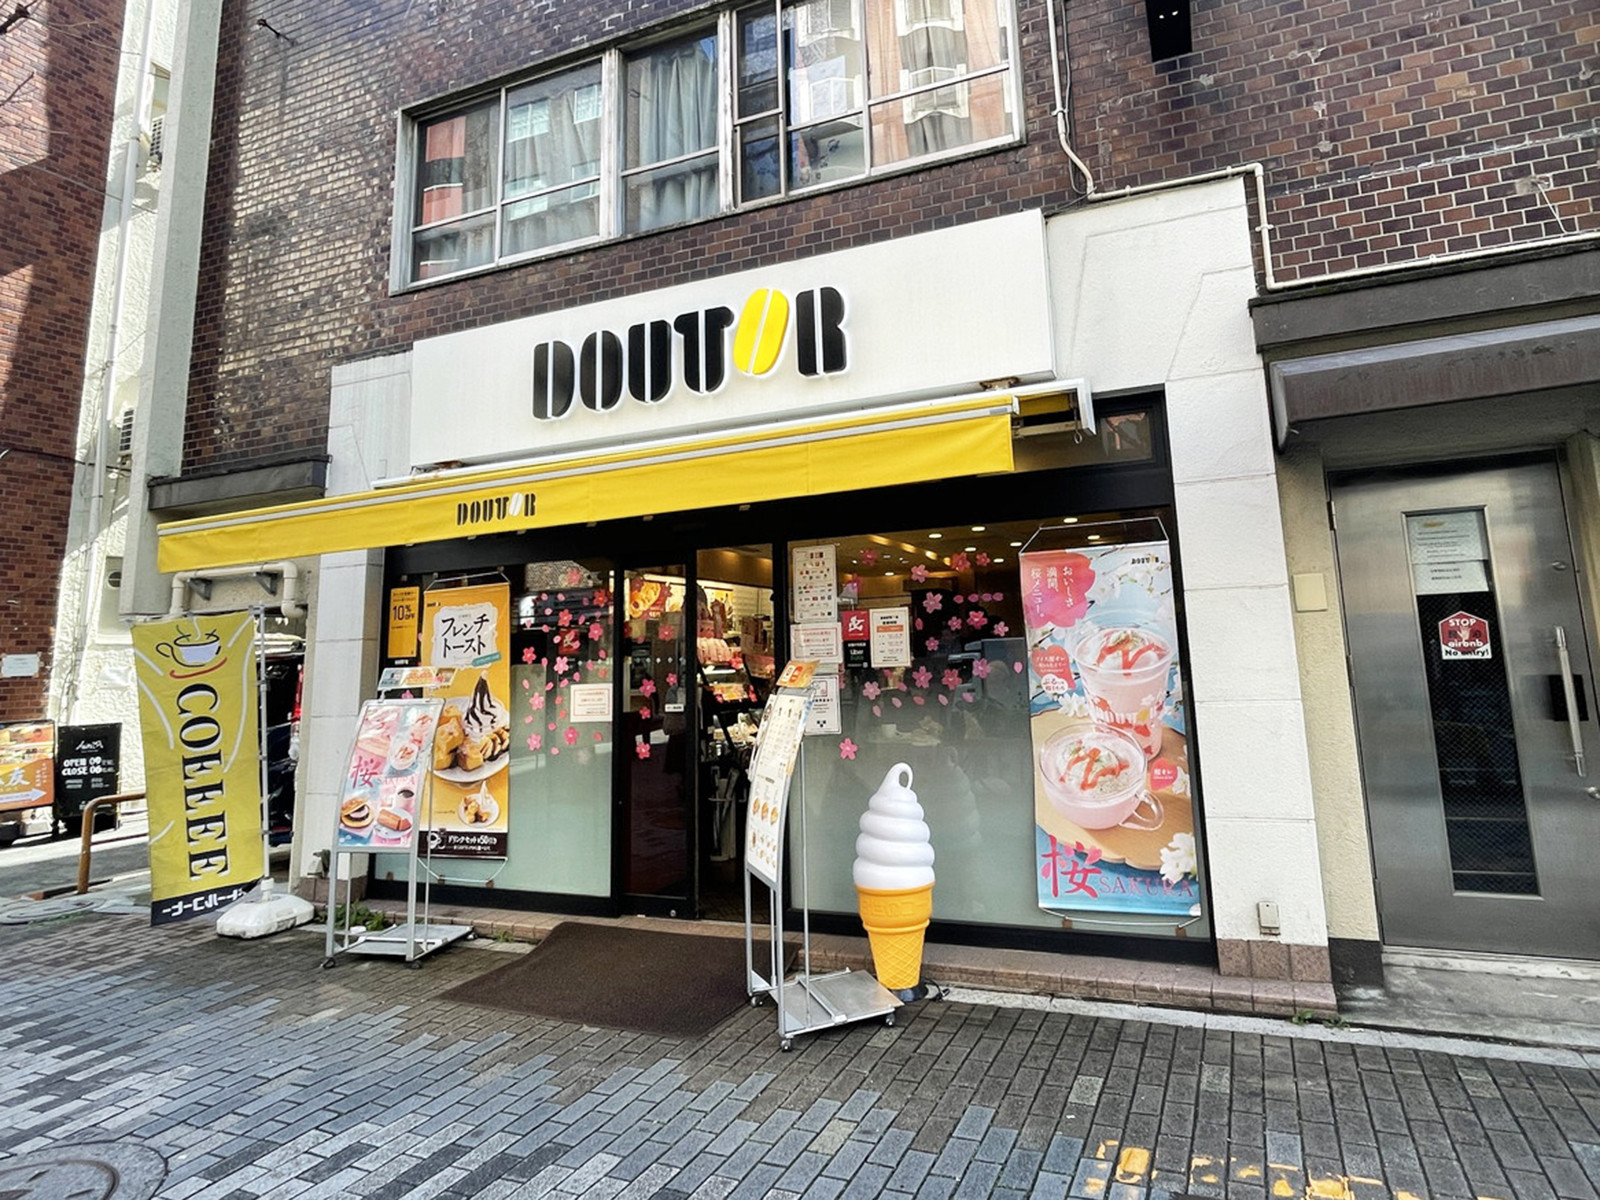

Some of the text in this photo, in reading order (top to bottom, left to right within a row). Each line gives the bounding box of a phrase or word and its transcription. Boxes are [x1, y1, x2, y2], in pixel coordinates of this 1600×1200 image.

[533, 286, 848, 420] DOUTOR
[457, 492, 536, 526] DOUTOR
[1031, 566, 1045, 618] 桜メニュー。
[1062, 566, 1075, 608] おいしさ
[441, 614, 490, 637] フレンチ
[1448, 618, 1476, 627] STOP
[443, 635, 487, 659] トースト
[1447, 639, 1484, 648] airbnb
[1461, 648, 1489, 657] entry!
[350, 755, 382, 789] 桜
[1040, 833, 1195, 899] 桜 SAKURA
